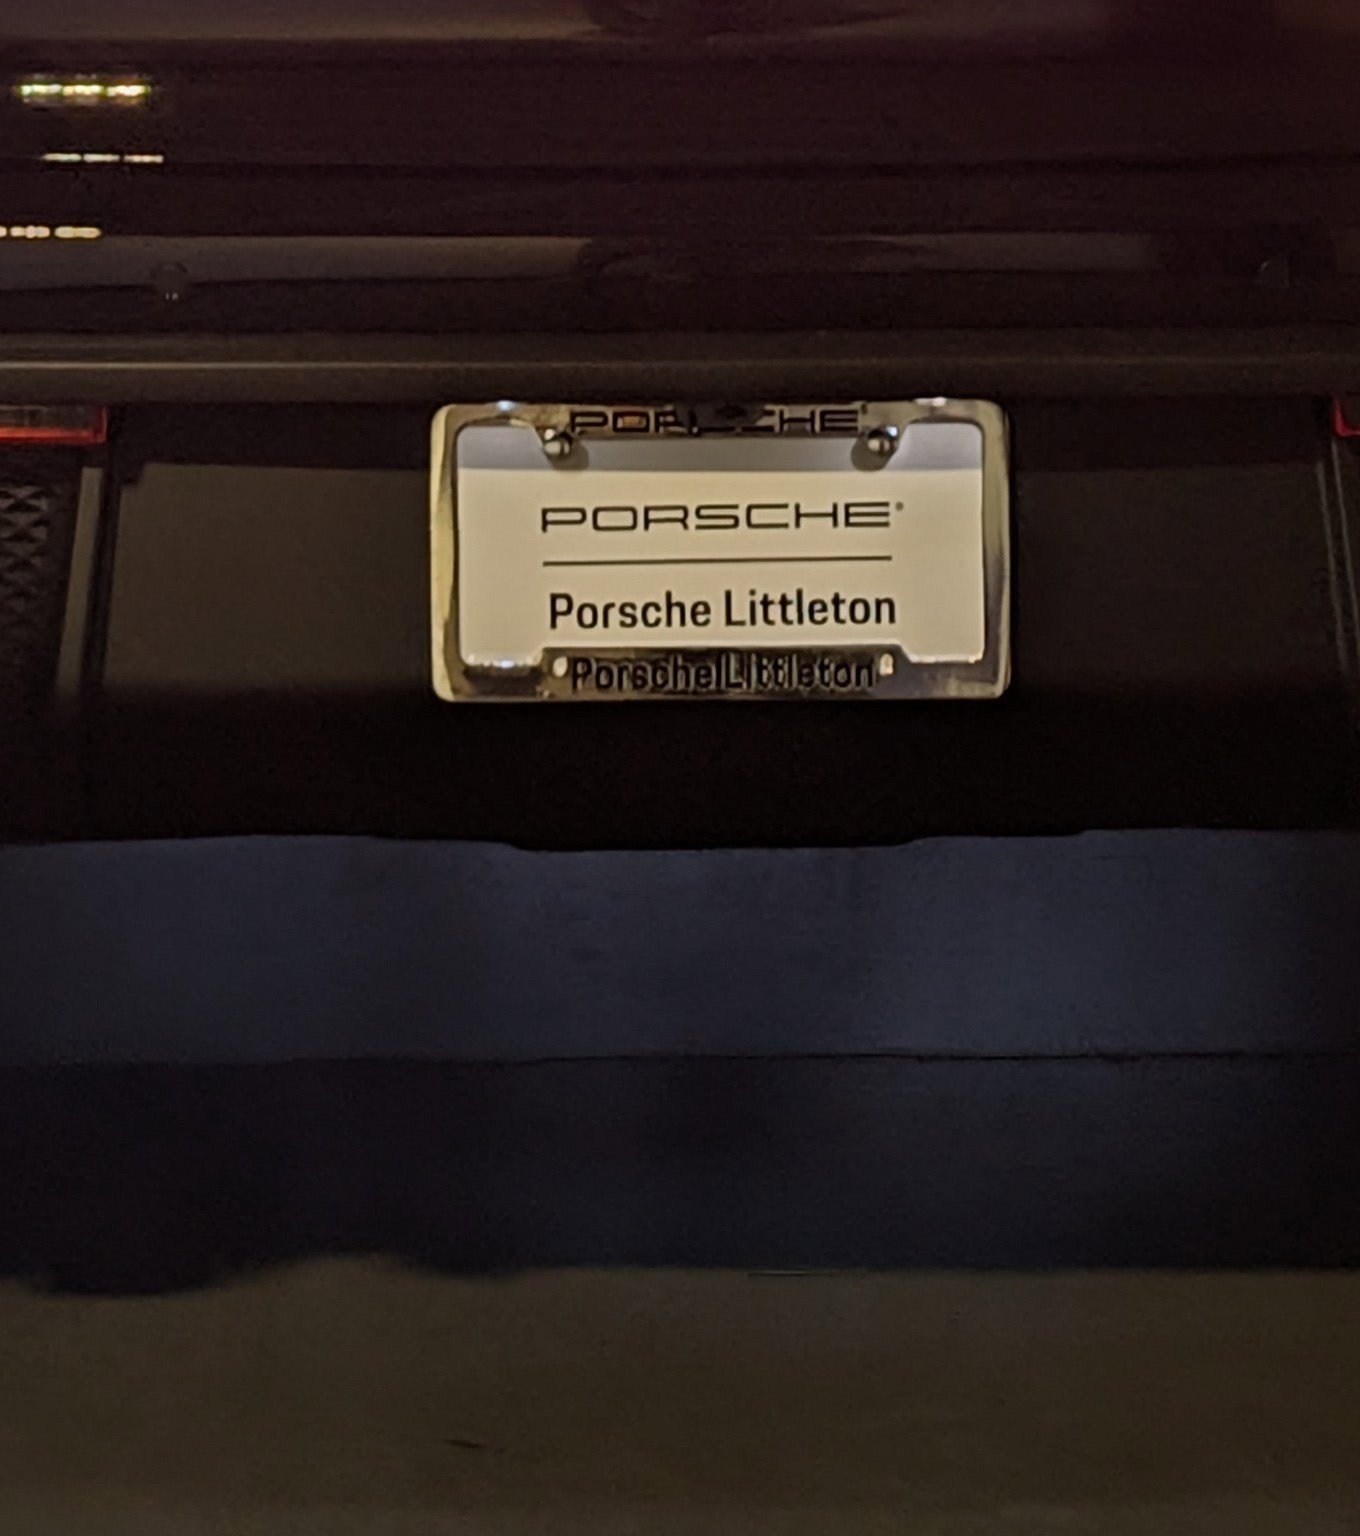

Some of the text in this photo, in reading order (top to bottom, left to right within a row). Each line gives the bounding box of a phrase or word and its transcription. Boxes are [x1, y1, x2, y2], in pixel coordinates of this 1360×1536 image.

[541, 501, 891, 533] PORSCHE
[549, 588, 897, 629] Porsche Littleton
[571, 652, 875, 692] Porsche Littleton
